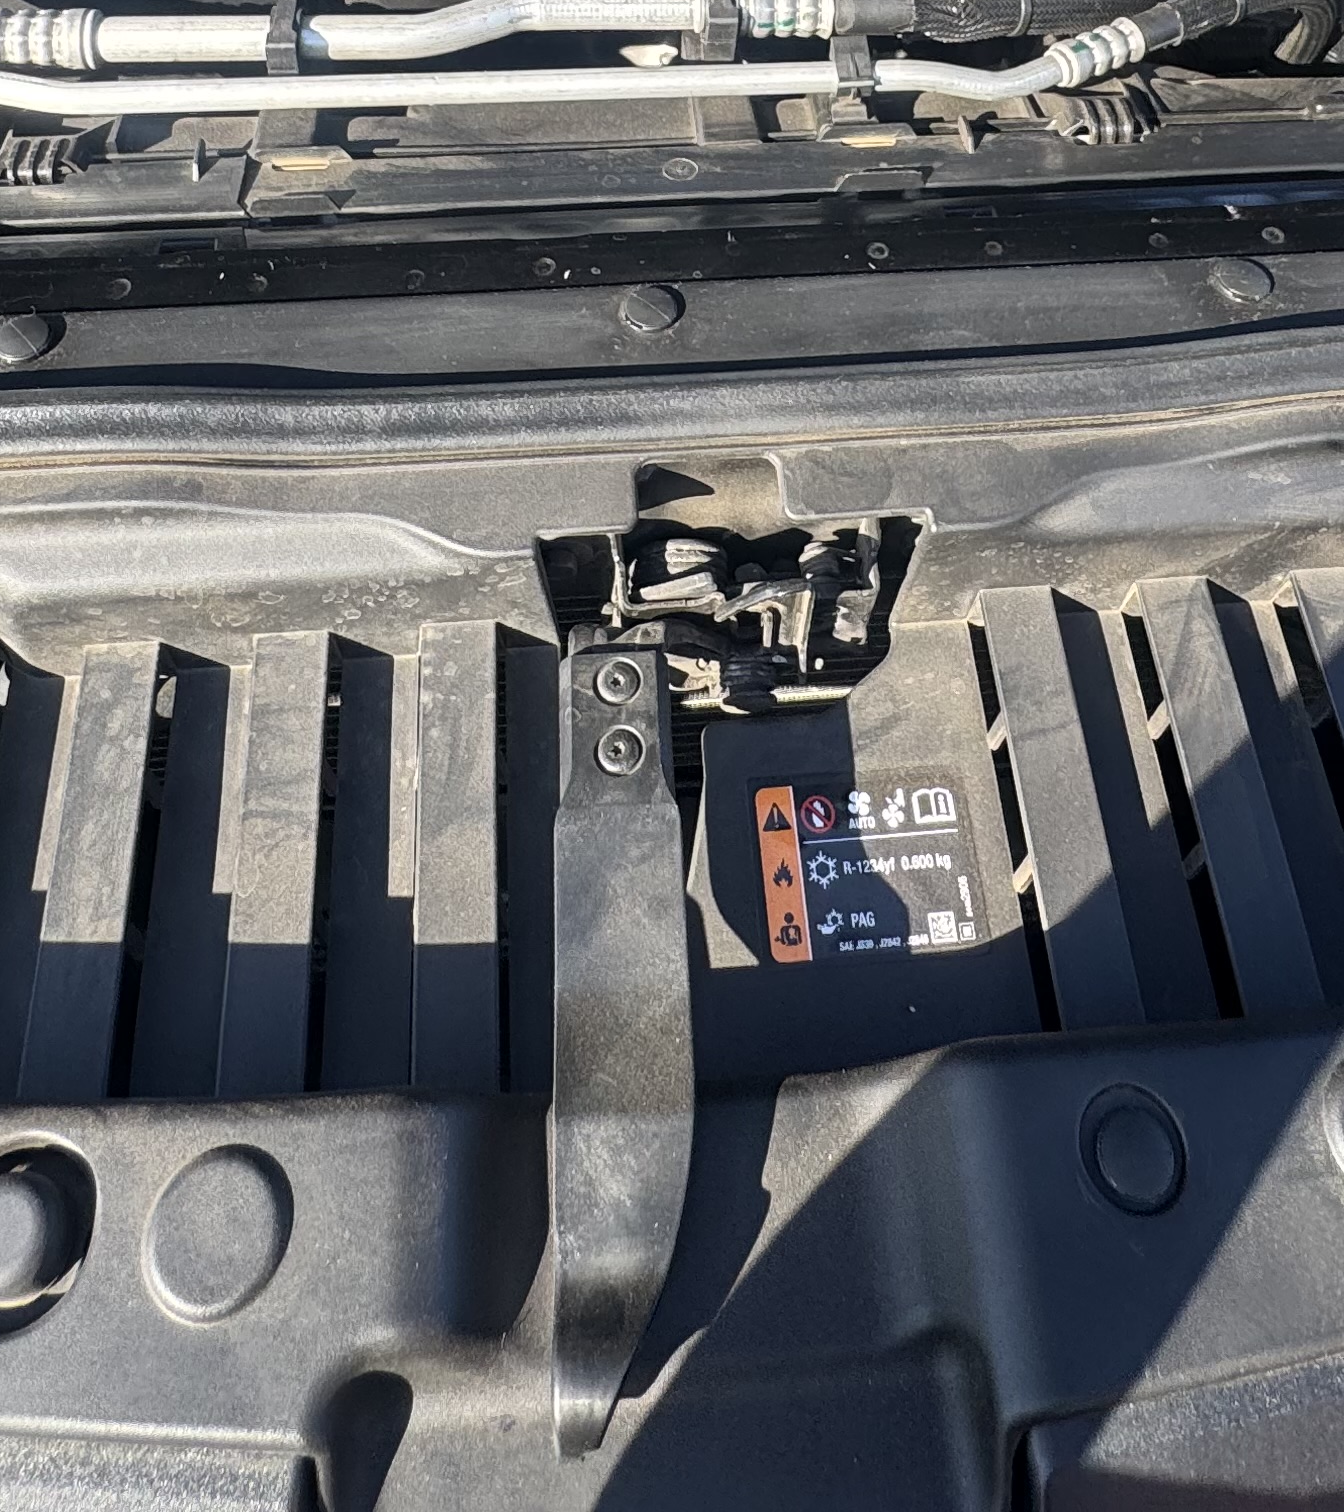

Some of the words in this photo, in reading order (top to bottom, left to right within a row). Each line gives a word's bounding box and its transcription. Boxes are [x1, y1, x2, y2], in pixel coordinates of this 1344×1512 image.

[848, 815, 876, 830] AUTO
[842, 856, 895, 876] R-1234yf
[935, 853, 952, 871] kg
[850, 911, 876, 928] PAG
